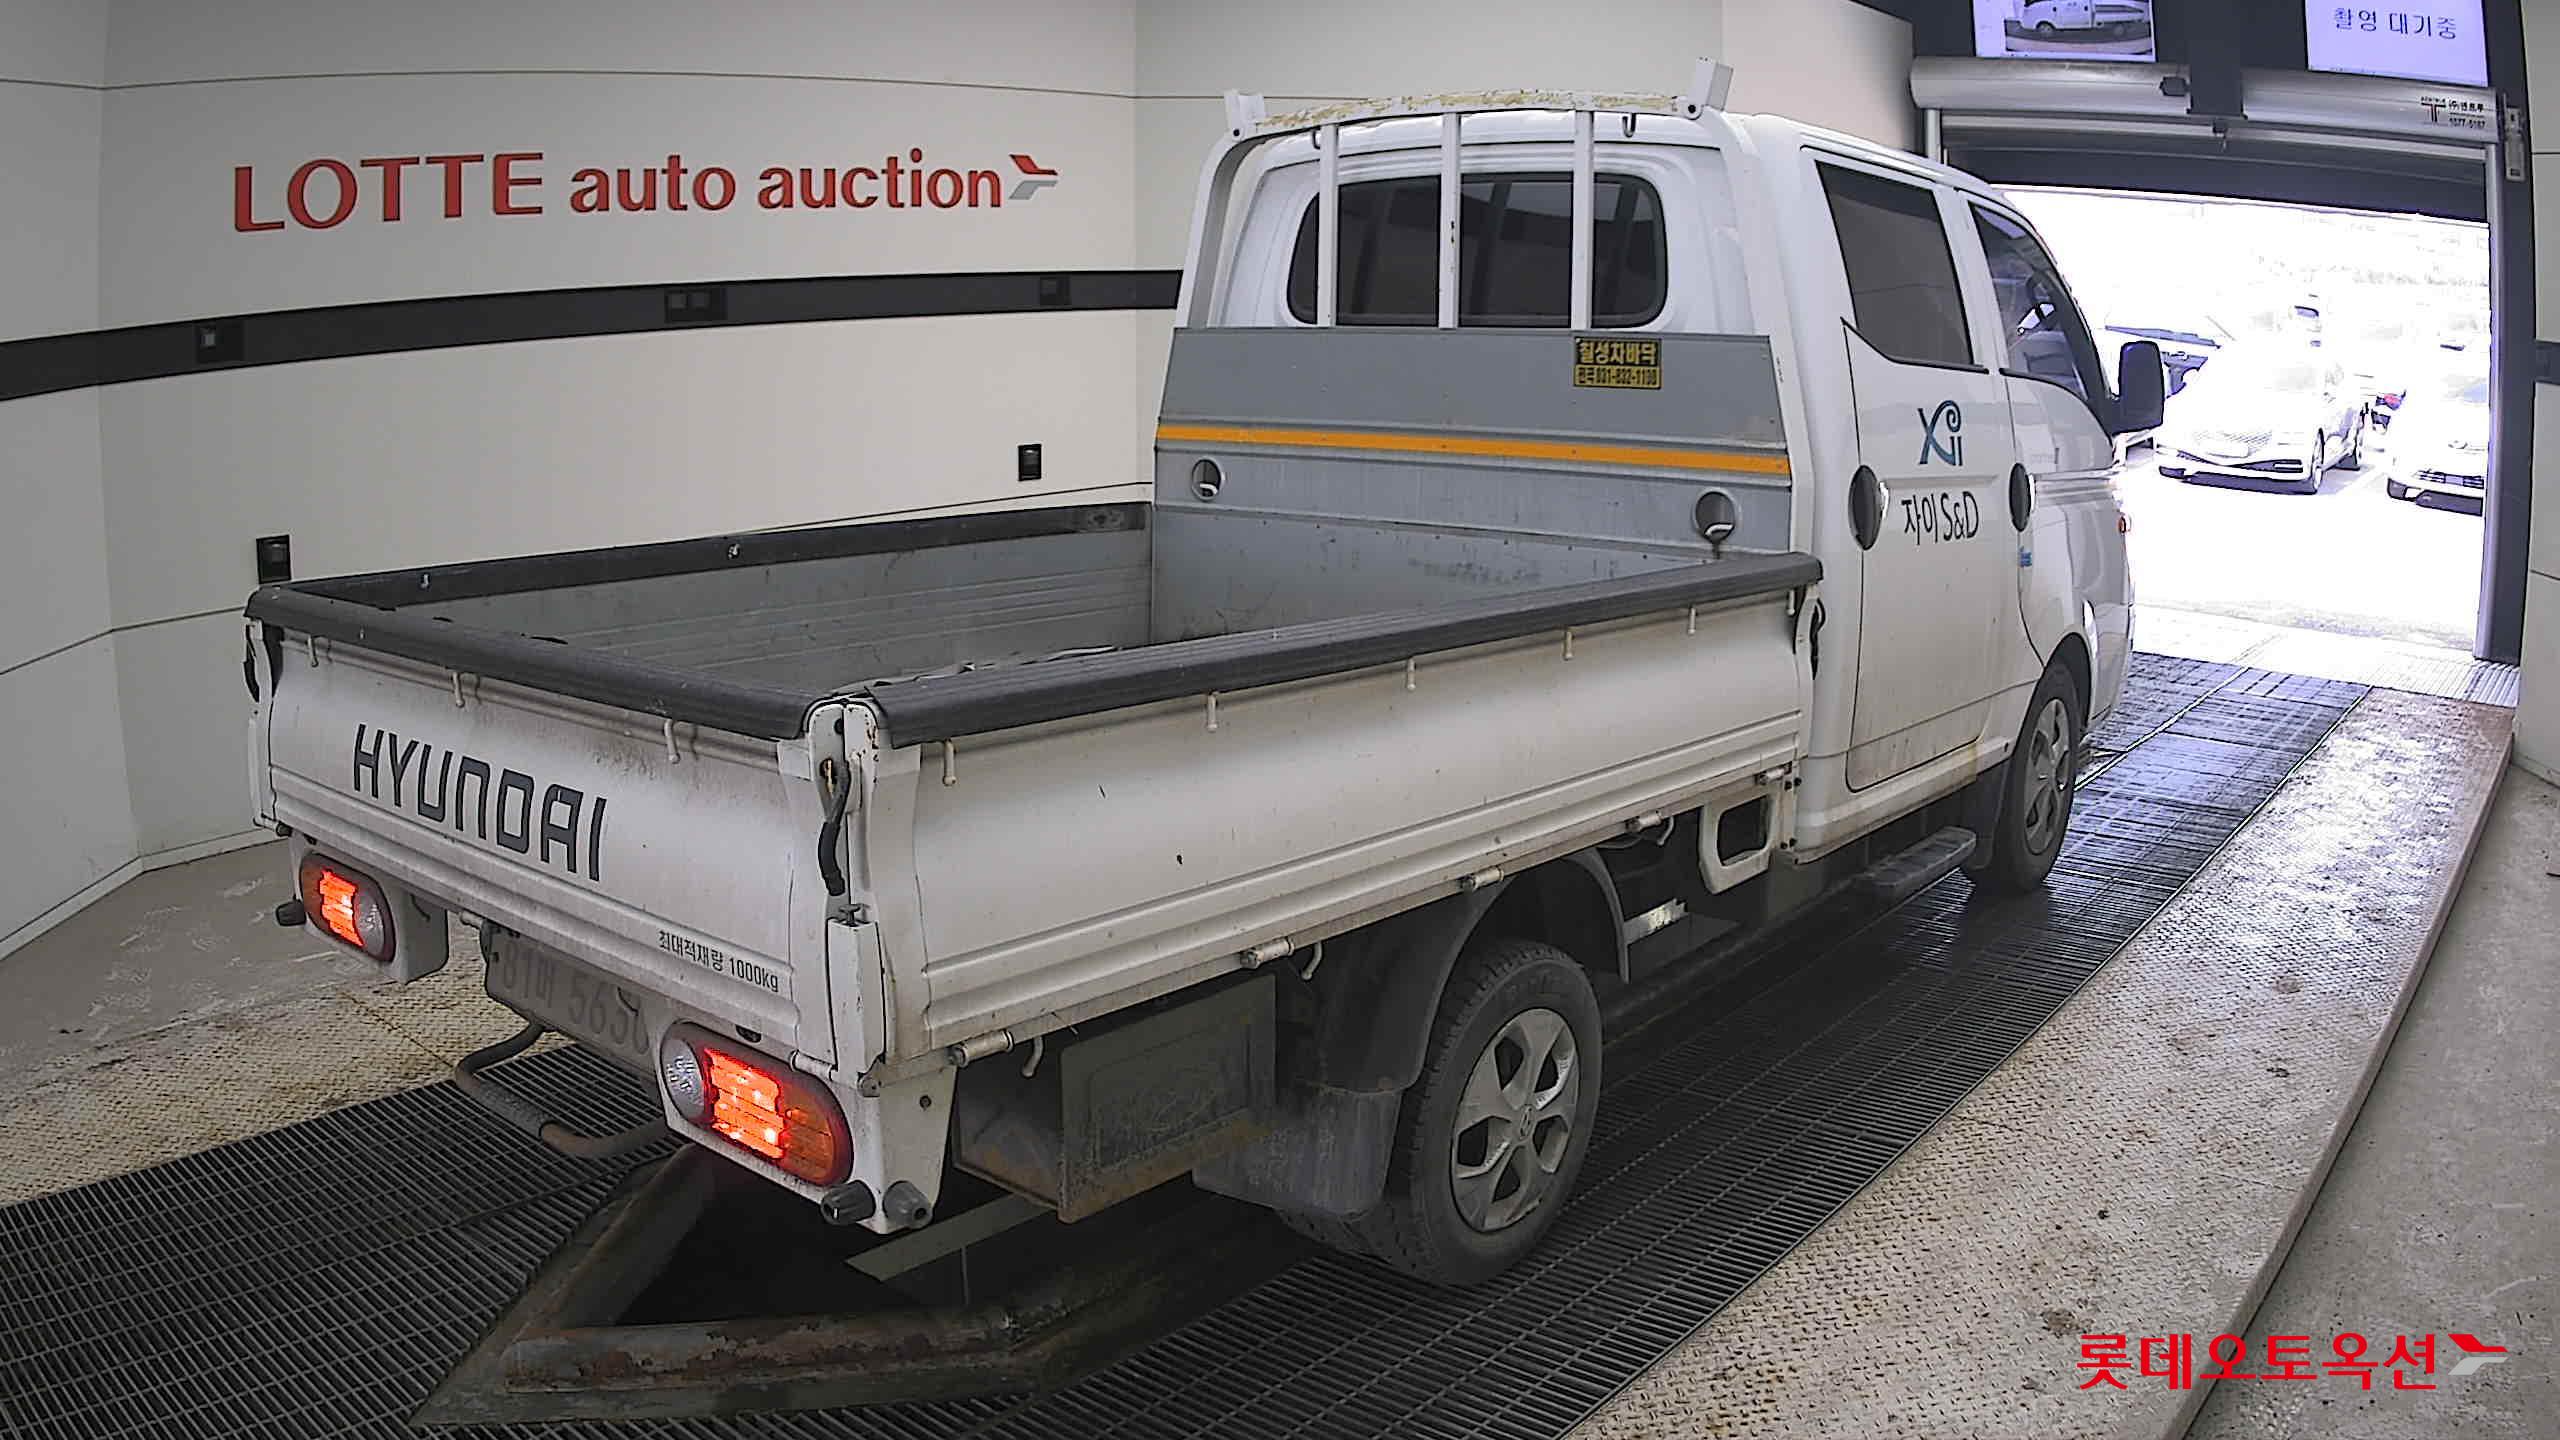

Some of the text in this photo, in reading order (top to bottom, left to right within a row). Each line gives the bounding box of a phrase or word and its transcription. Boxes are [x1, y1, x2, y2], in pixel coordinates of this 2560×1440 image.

[2335, 8, 2377, 32] 촬영
[234, 147, 1002, 232] LOTTE auto auction
[353, 723, 607, 882] HYUNDAI
[658, 930, 723, 972] 최대적재량
